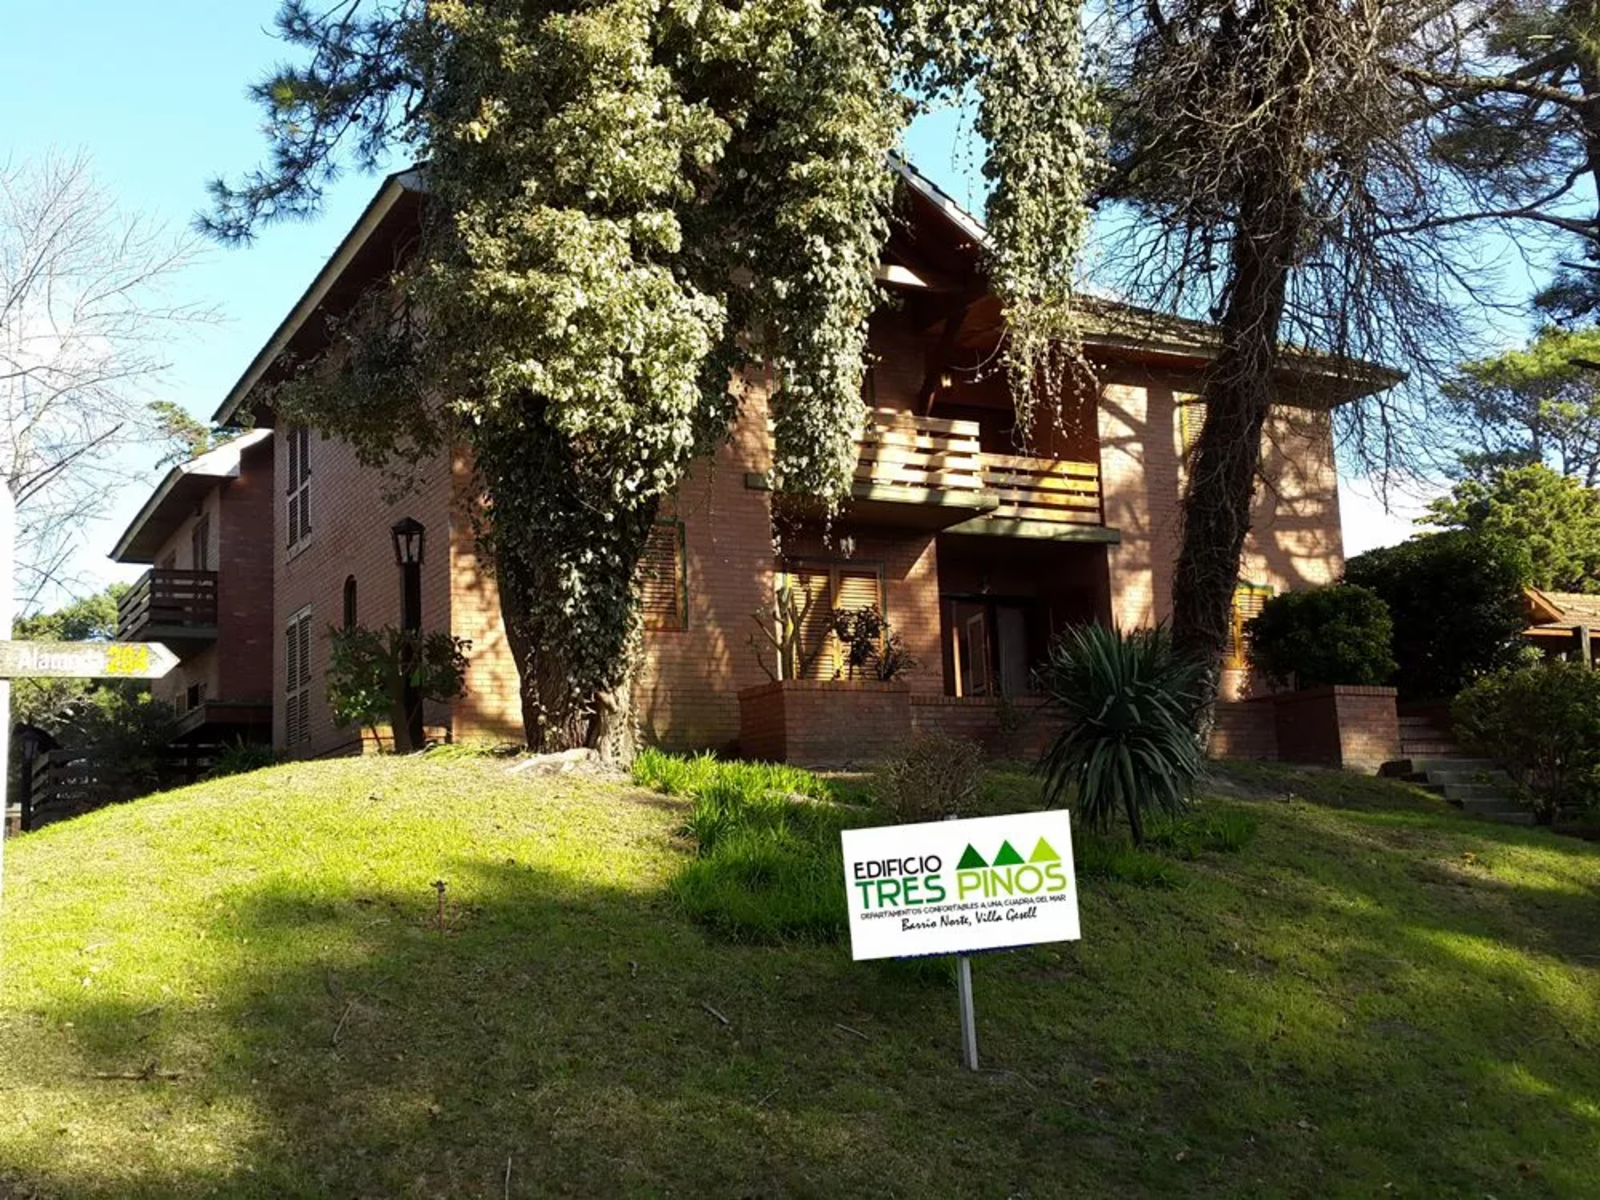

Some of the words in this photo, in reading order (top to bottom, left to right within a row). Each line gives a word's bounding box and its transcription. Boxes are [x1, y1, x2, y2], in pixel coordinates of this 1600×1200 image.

[18, 648, 104, 670] Alam
[854, 855, 942, 879] EDIFICIO
[854, 874, 946, 909] TRES
[957, 863, 1067, 900] PINOS
[861, 907, 922, 920] DEPARTAMENTOS
[923, 903, 978, 914] CONFORTABLES
[986, 899, 1004, 908] UNA
[1003, 896, 1035, 906] CUADRA
[1035, 895, 1049, 903] DEL
[1049, 894, 1067, 902] MAR
[902, 918, 937, 932] Barrio
[940, 915, 971, 927] Norte,
[975, 909, 1003, 924] Villa
[1005, 906, 1037, 922] Gesell
